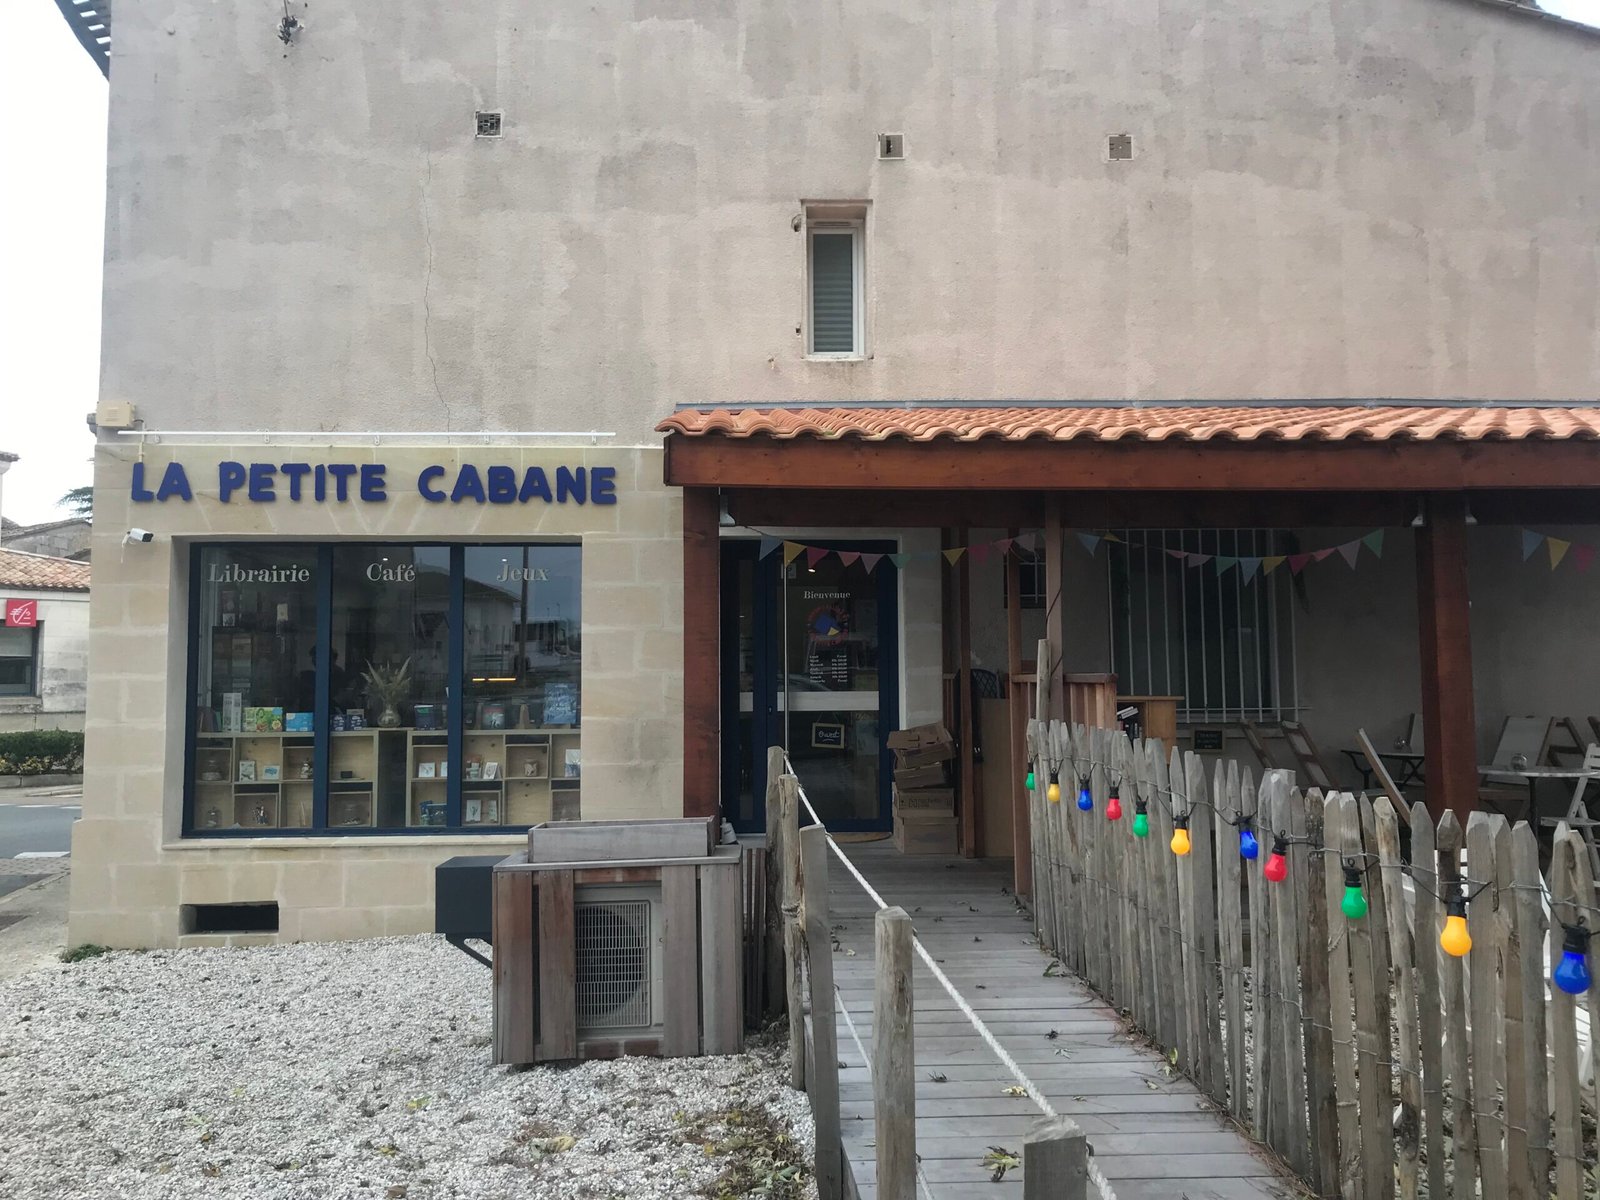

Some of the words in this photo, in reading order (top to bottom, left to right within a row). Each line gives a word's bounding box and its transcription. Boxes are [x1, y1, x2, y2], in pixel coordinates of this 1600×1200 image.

[131, 462, 192, 502] LA
[219, 462, 387, 502] PETITE
[418, 465, 617, 505] CABANE
[208, 563, 311, 583] Librairie
[366, 563, 416, 582] Café
[497, 563, 550, 582] Jeux
[803, 590, 851, 600] Bienvenue
